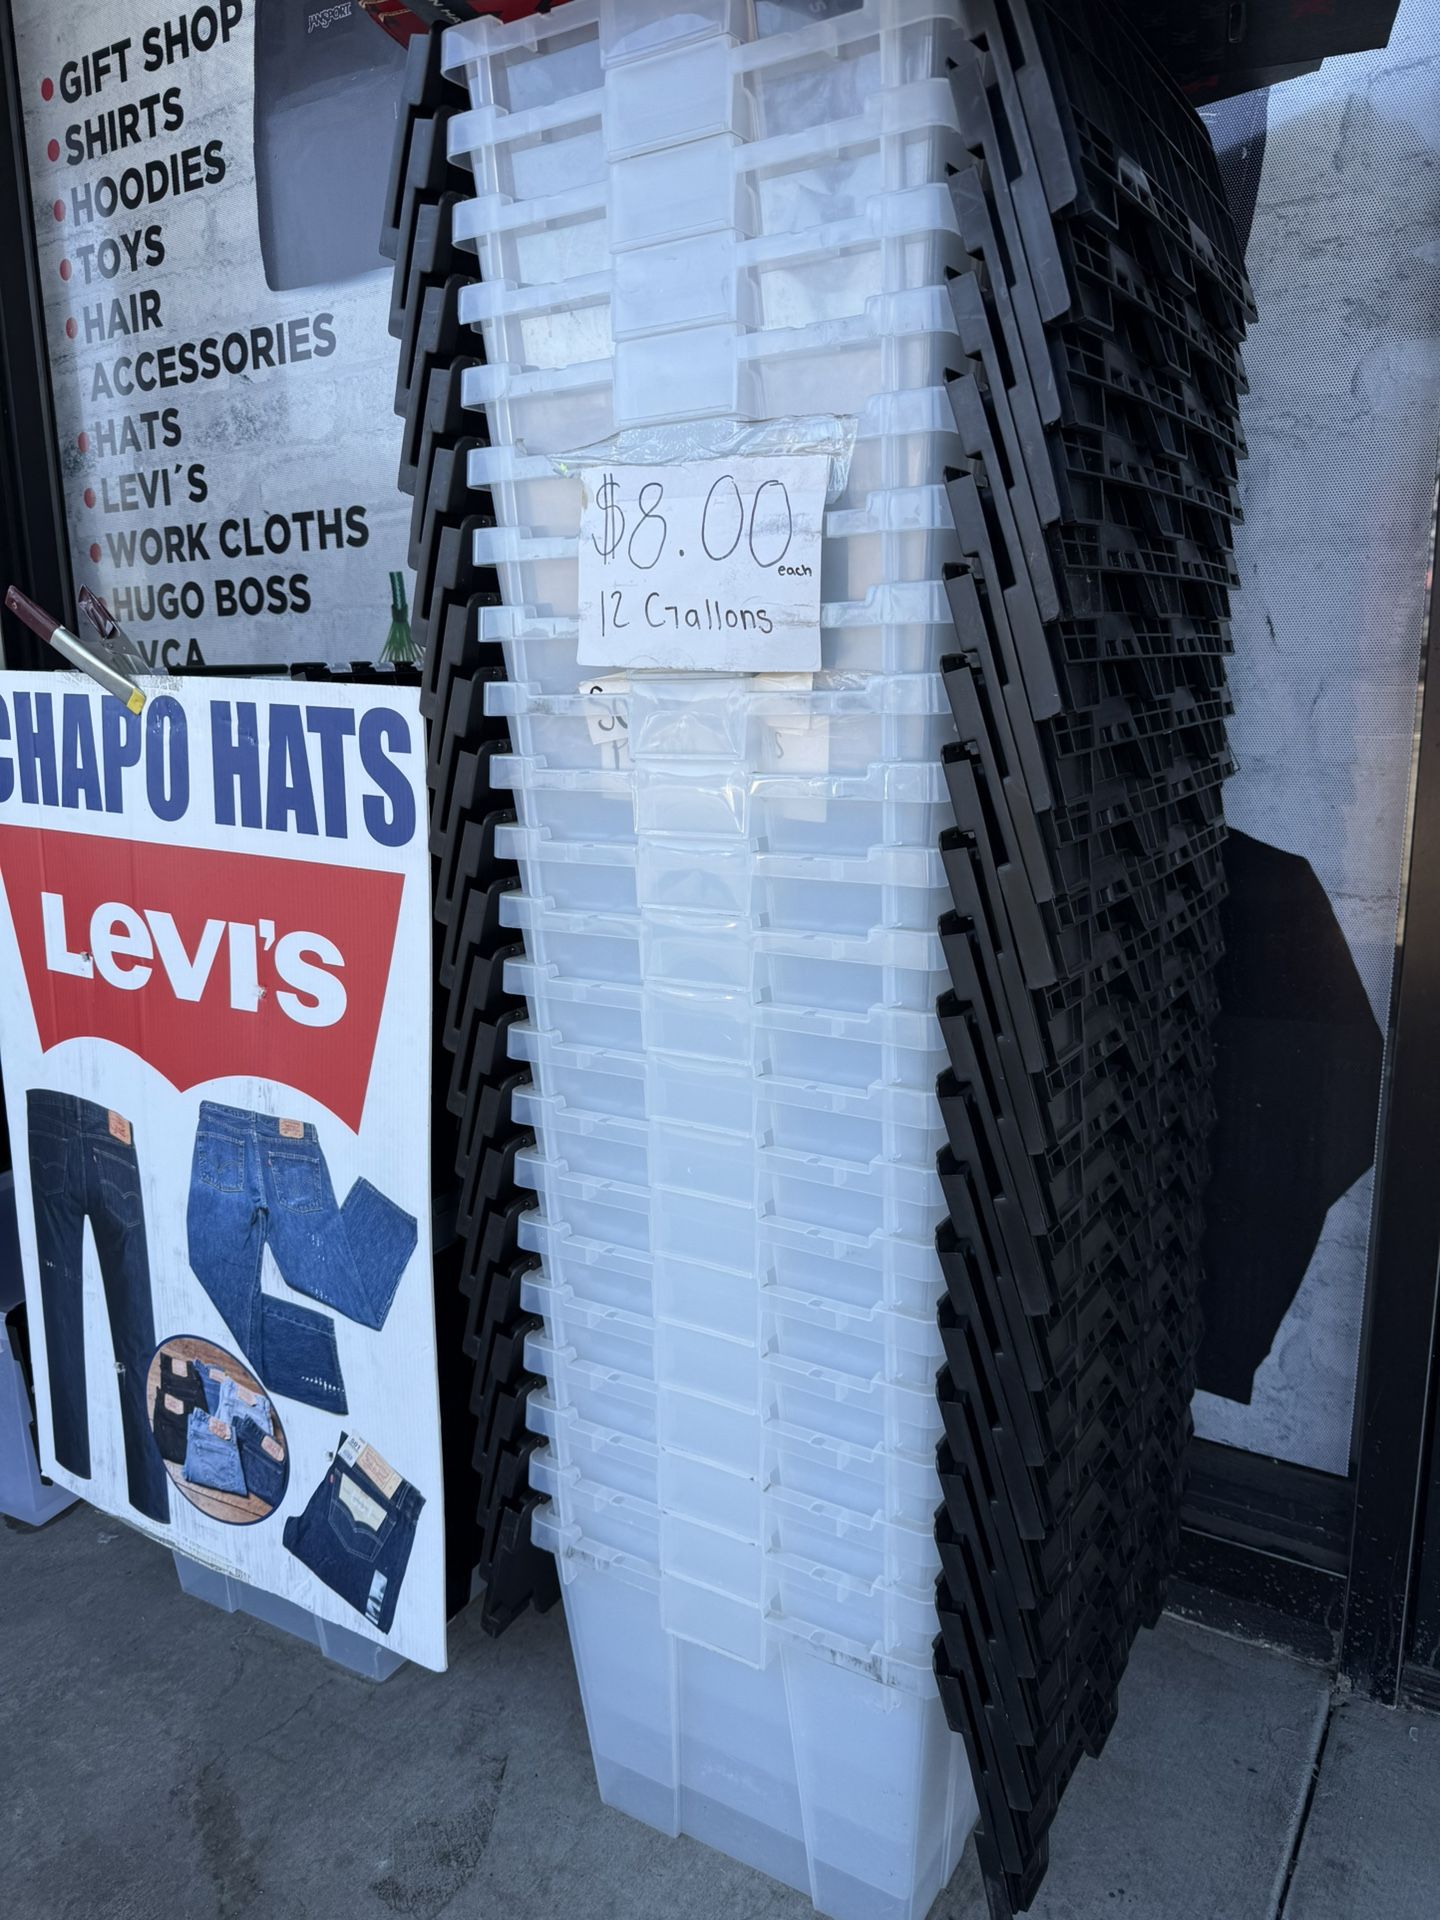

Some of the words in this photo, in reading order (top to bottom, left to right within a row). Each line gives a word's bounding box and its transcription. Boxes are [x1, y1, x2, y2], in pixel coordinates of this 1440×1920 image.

[60, 38, 131, 103] GIFT
[142, 0, 243, 72] SHOP
[66, 87, 184, 165] SHIRTS
[71, 140, 226, 226] HOODIES
[77, 225, 164, 284] TOYS
[83, 289, 163, 344] HAIR
[91, 313, 337, 401] ACCESSORIES
[95, 408, 182, 457] HATS
[101, 464, 208, 513] LEVI'S
[106, 522, 210, 568] WORK
[219, 506, 369, 558] CLOTHS
[592, 473, 792, 569] $8.00
[778, 564, 812, 577] each
[112, 581, 204, 622] HUGO
[214, 574, 311, 617] BOSS
[601, 591, 630, 637] 12
[645, 592, 773, 634] Gallons
[138, 638, 206, 667] VCA
[210, 699, 416, 847] HATS
